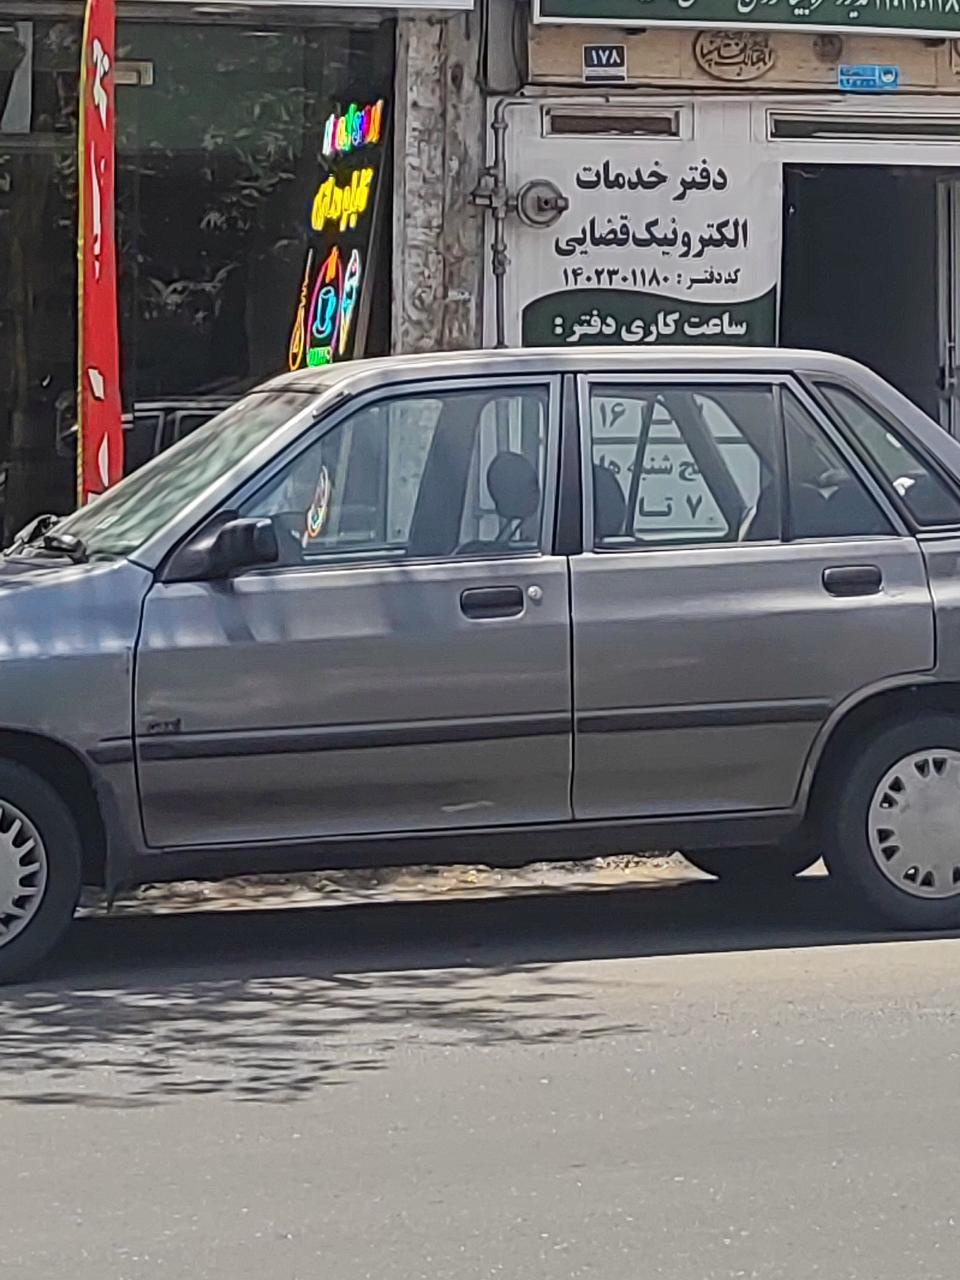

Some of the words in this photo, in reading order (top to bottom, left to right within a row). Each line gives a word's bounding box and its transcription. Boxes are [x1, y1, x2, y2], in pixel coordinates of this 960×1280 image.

[591, 48, 621, 65] ۱۷۸
[575, 159, 669, 190] خدمات
[671, 158, 728, 201] دفتر
[554, 214, 631, 257] قضایی
[631, 216, 748, 259] الکترونیک
[562, 267, 670, 287] ۱۴۰۲۳۰۱۱۸۰
[725, 267, 741, 284] کد
[620, 310, 680, 342] کاری
[683, 311, 747, 335] ساعت
[599, 401, 627, 429] ۱۶
[686, 494, 703, 519] ۷
